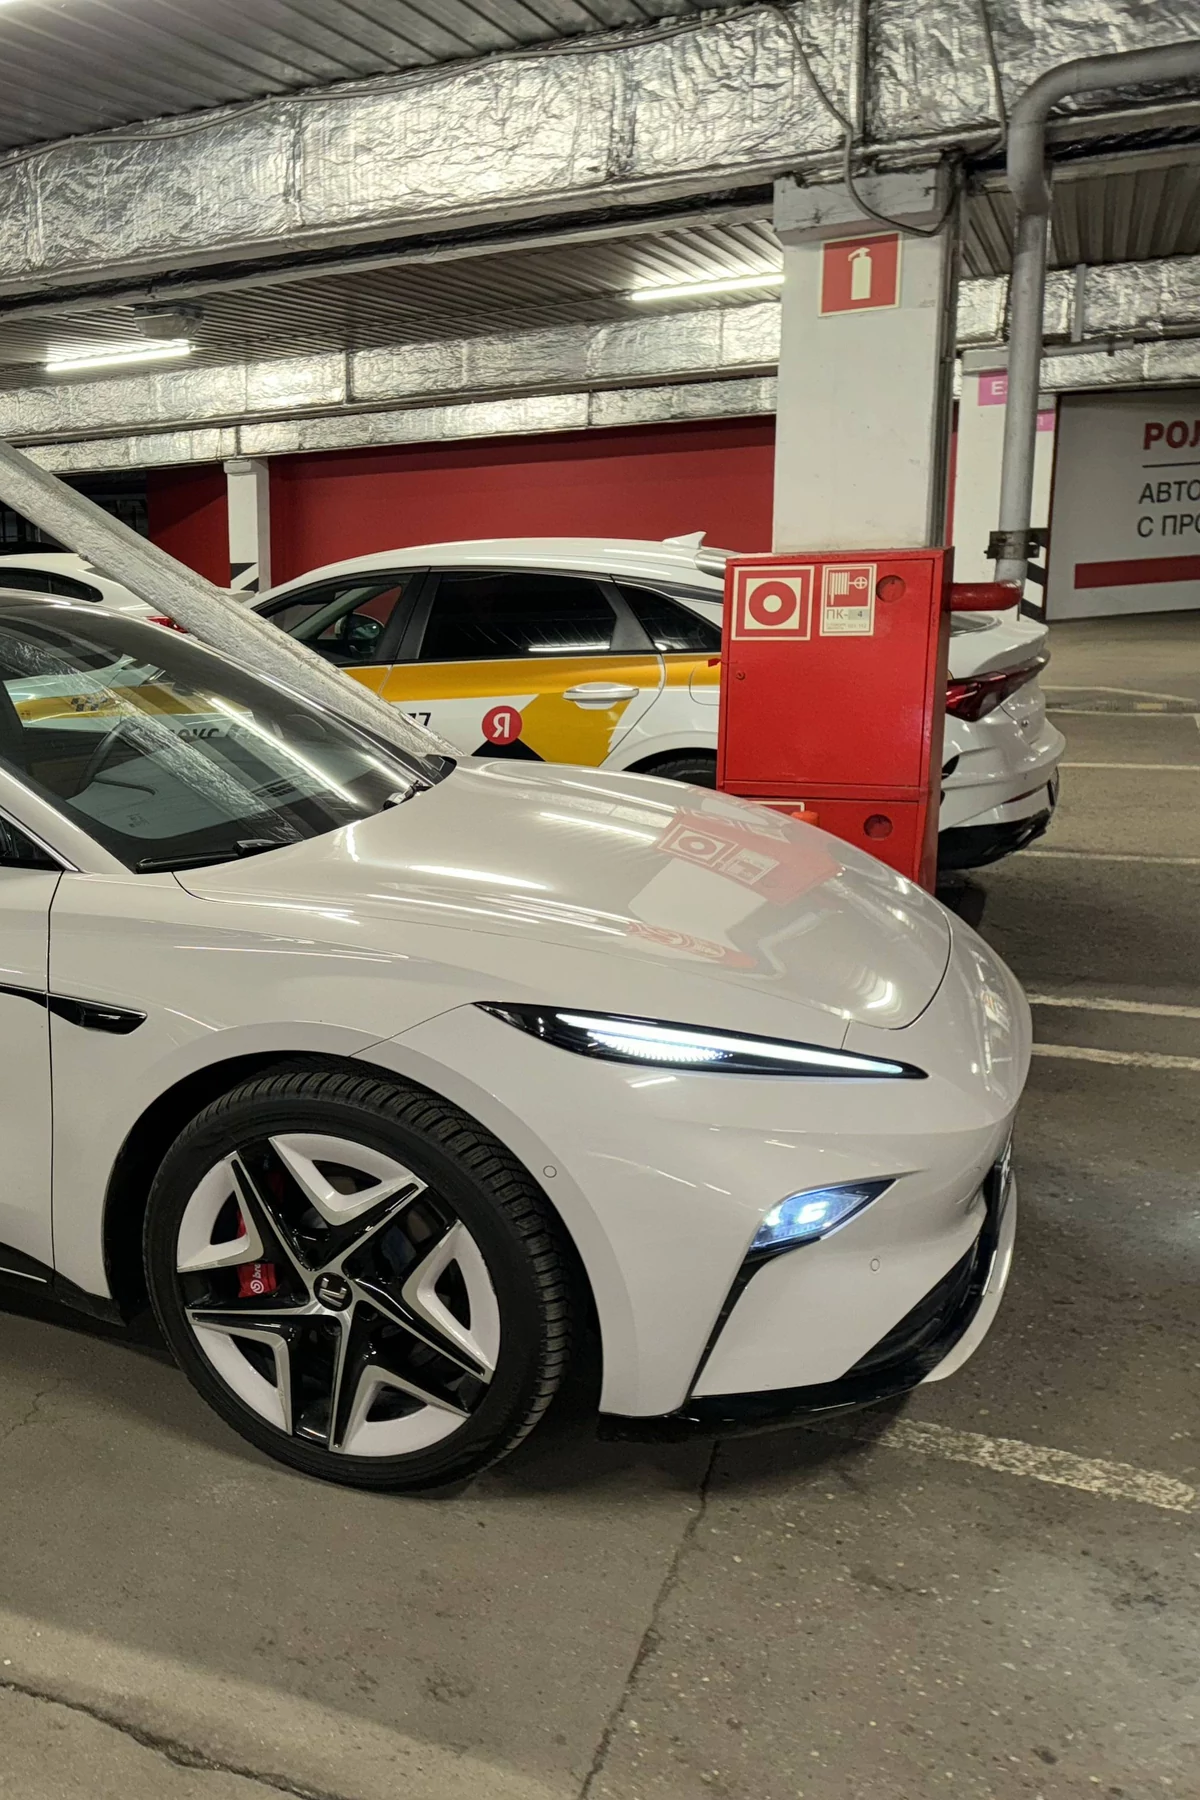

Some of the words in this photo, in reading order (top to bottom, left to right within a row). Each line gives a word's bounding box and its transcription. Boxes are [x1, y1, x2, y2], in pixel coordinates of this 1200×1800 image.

[991, 380, 1007, 396] E
[1137, 516, 1154, 538] С
[492, 712, 511, 738] Я
